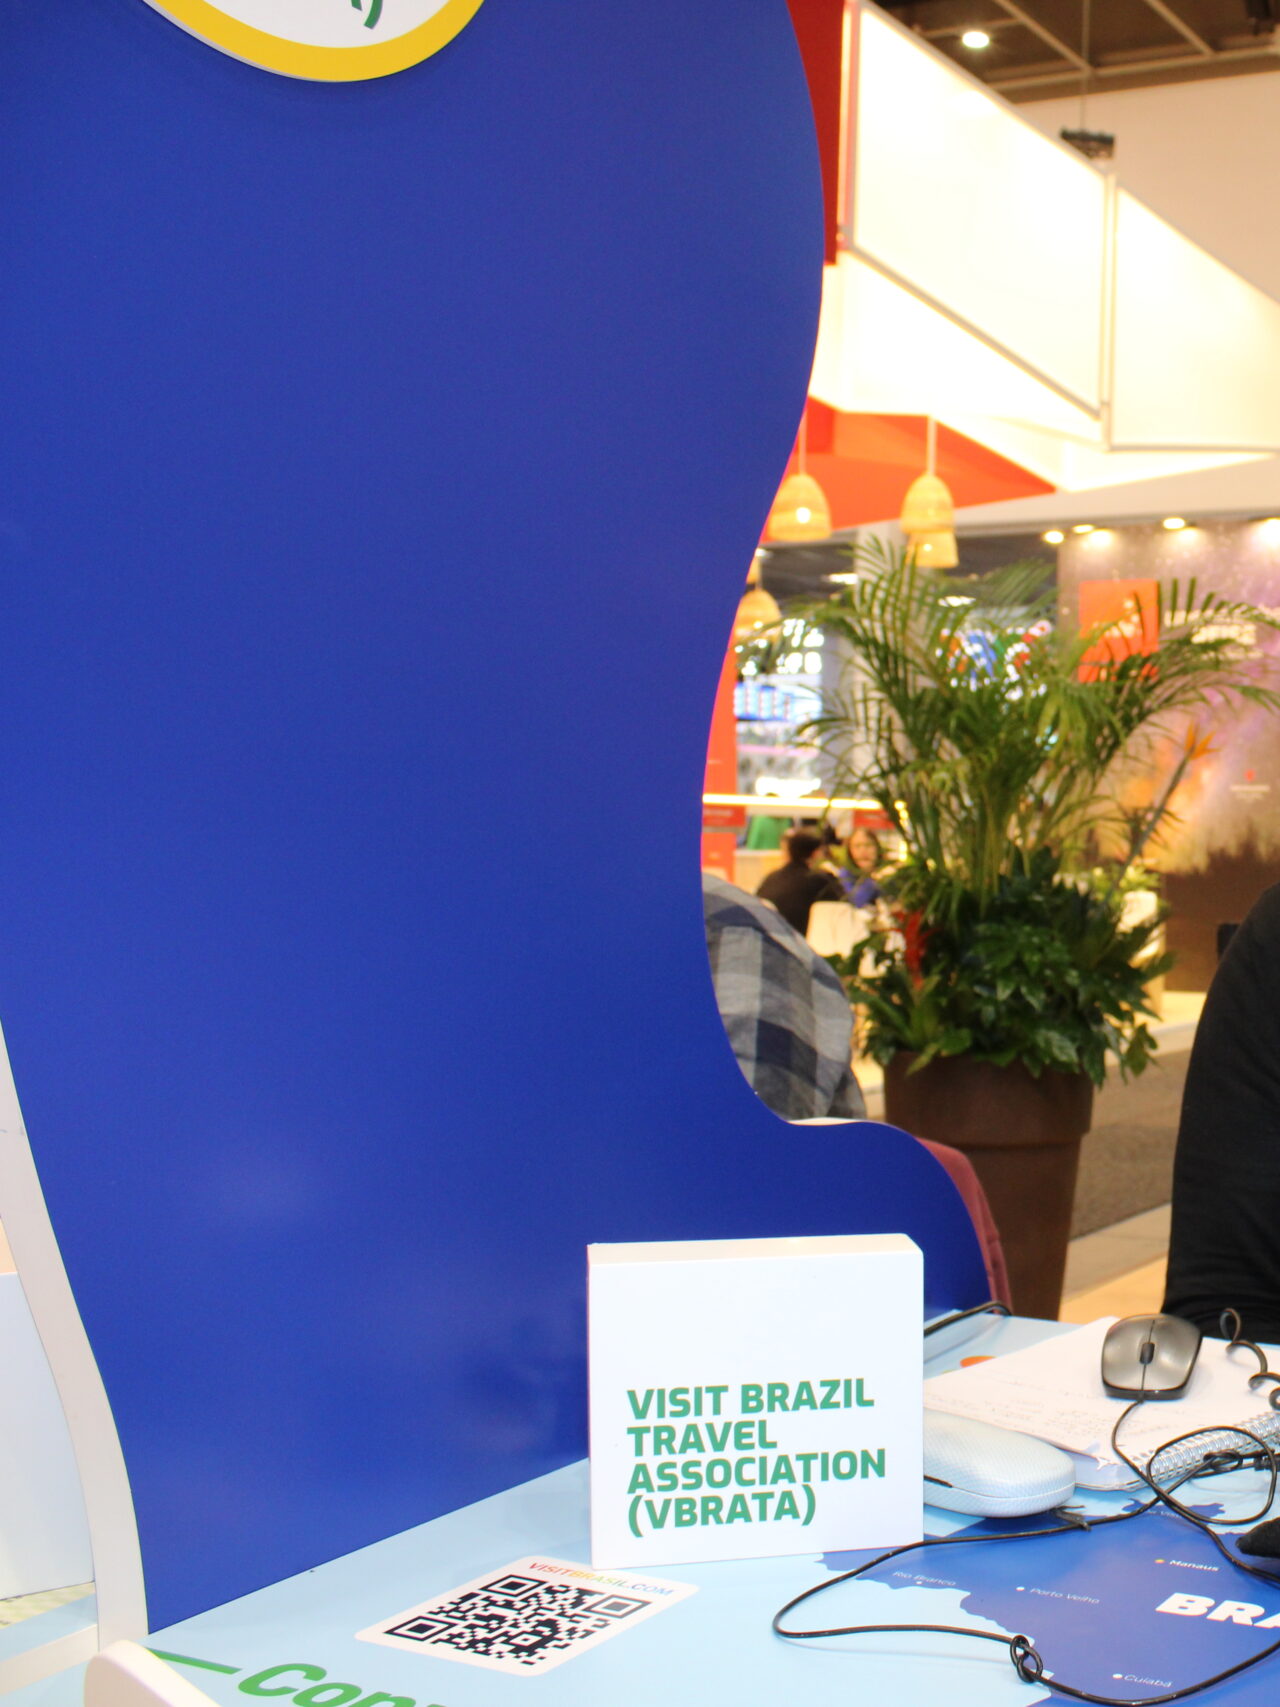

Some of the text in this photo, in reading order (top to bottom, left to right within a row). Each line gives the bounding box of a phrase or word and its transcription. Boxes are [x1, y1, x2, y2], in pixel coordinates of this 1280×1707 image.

[627, 1378, 875, 1420] VISIT BRAZIL
[627, 1419, 778, 1457] TRAVEL
[627, 1448, 886, 1494] ASSOCIATION
[628, 1484, 816, 1538] (VBRATA)
[529, 1562, 674, 1596] VISITBRASIL.COM
[1169, 1559, 1219, 1572] Manaus
[1030, 1588, 1063, 1598] Porto
